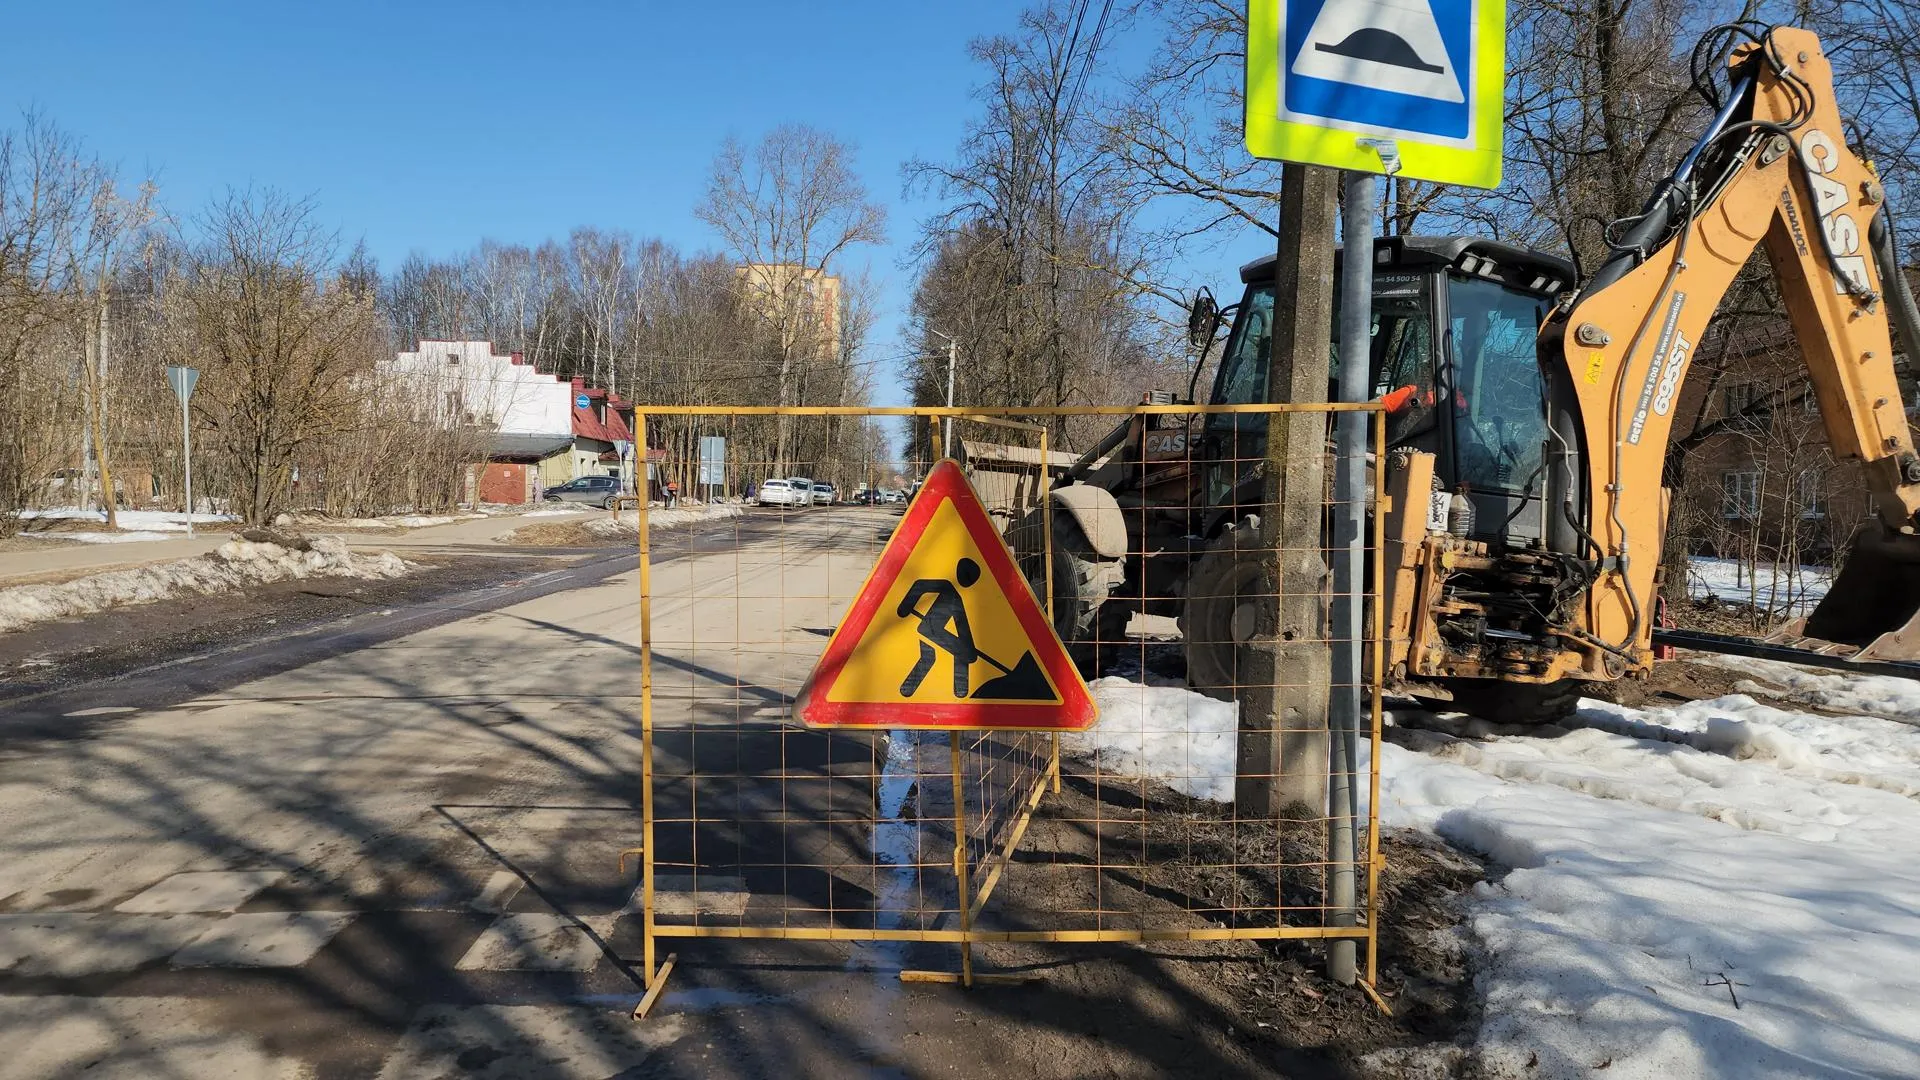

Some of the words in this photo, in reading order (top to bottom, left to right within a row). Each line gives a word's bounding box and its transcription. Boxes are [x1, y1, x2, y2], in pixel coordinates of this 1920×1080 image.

[1800, 129, 1873, 295] CASE
[1644, 384, 1654, 396] 54
[1649, 366, 1659, 383] 500
[1654, 354, 1663, 367] 54
[1653, 330, 1691, 416] 695ST
